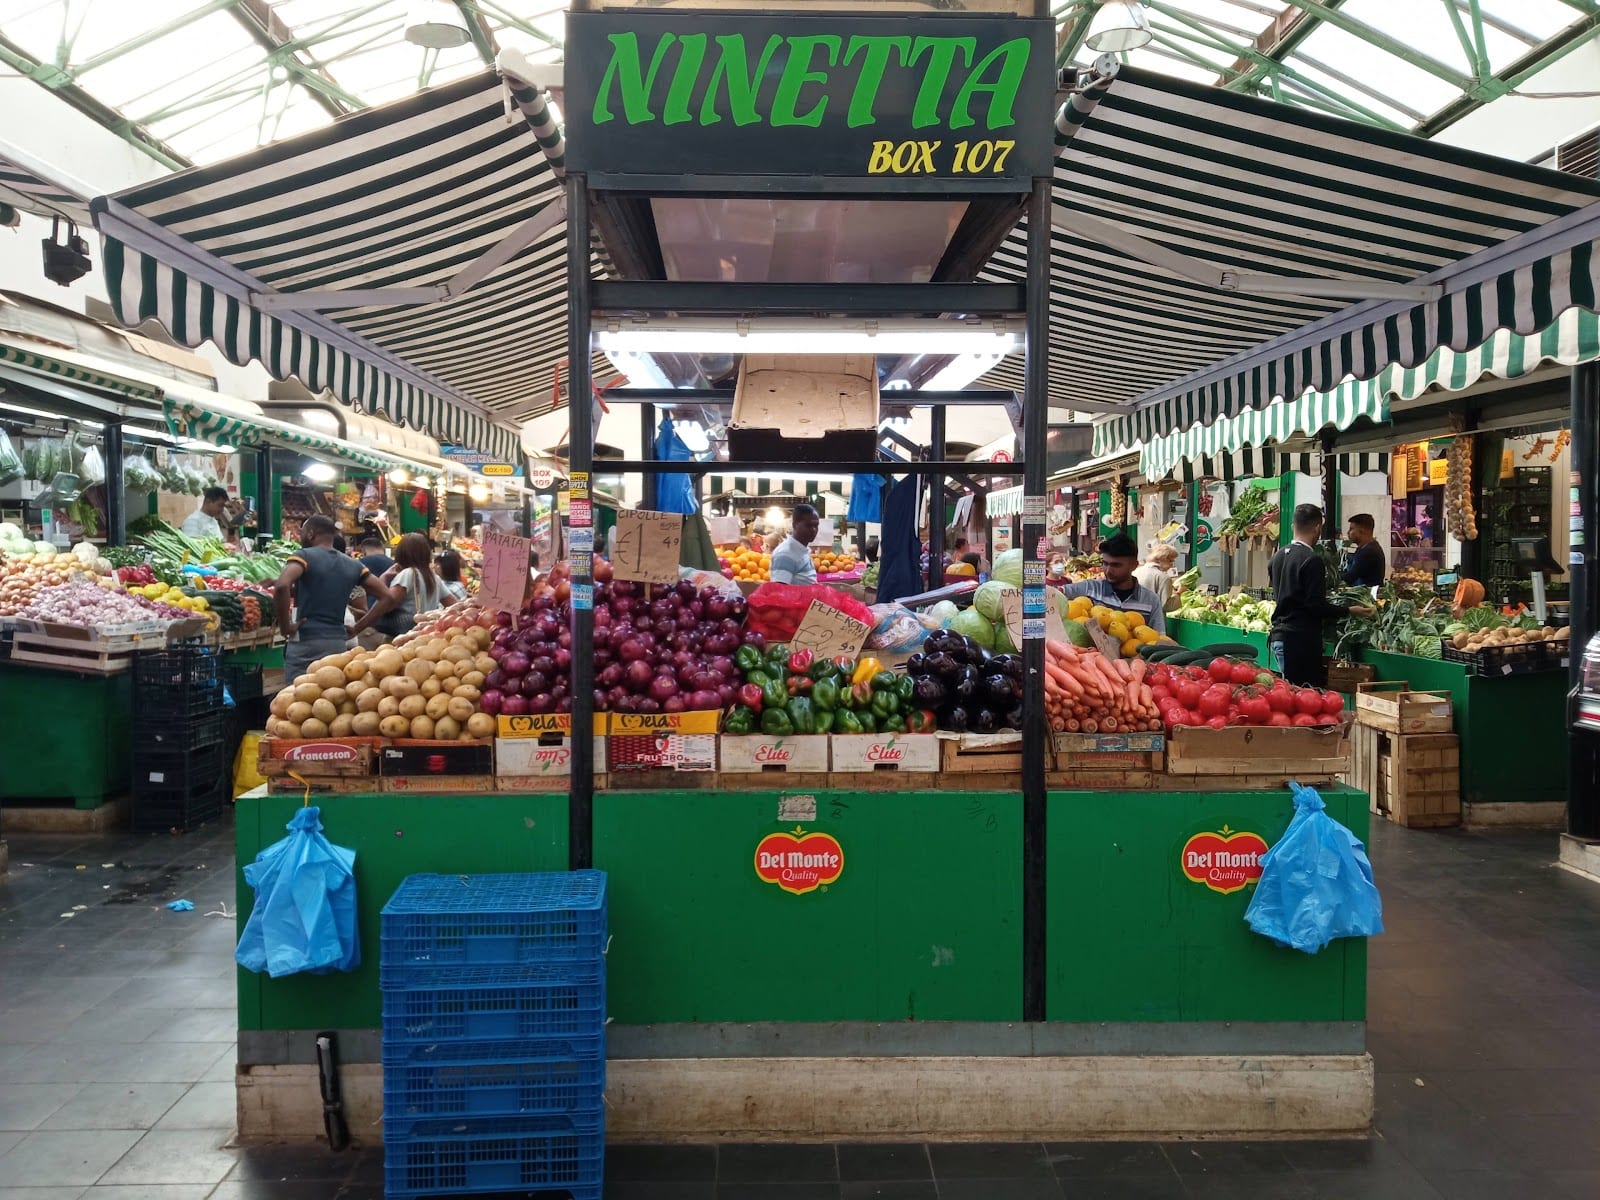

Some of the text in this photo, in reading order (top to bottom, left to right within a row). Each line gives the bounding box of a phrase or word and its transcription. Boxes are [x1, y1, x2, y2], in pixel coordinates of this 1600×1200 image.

[592, 32, 1031, 130] NINETTA
[867, 140, 1015, 174] BOX 107
[618, 509, 668, 521] CIPOLLE
[484, 531, 524, 549] PATATA
[755, 745, 789, 761] Elite
[867, 744, 901, 761] Elite
[760, 851, 839, 868] Del Monte
[1187, 851, 1212, 868] Del
[782, 868, 818, 882] Quality
[1209, 868, 1245, 882] Quality
